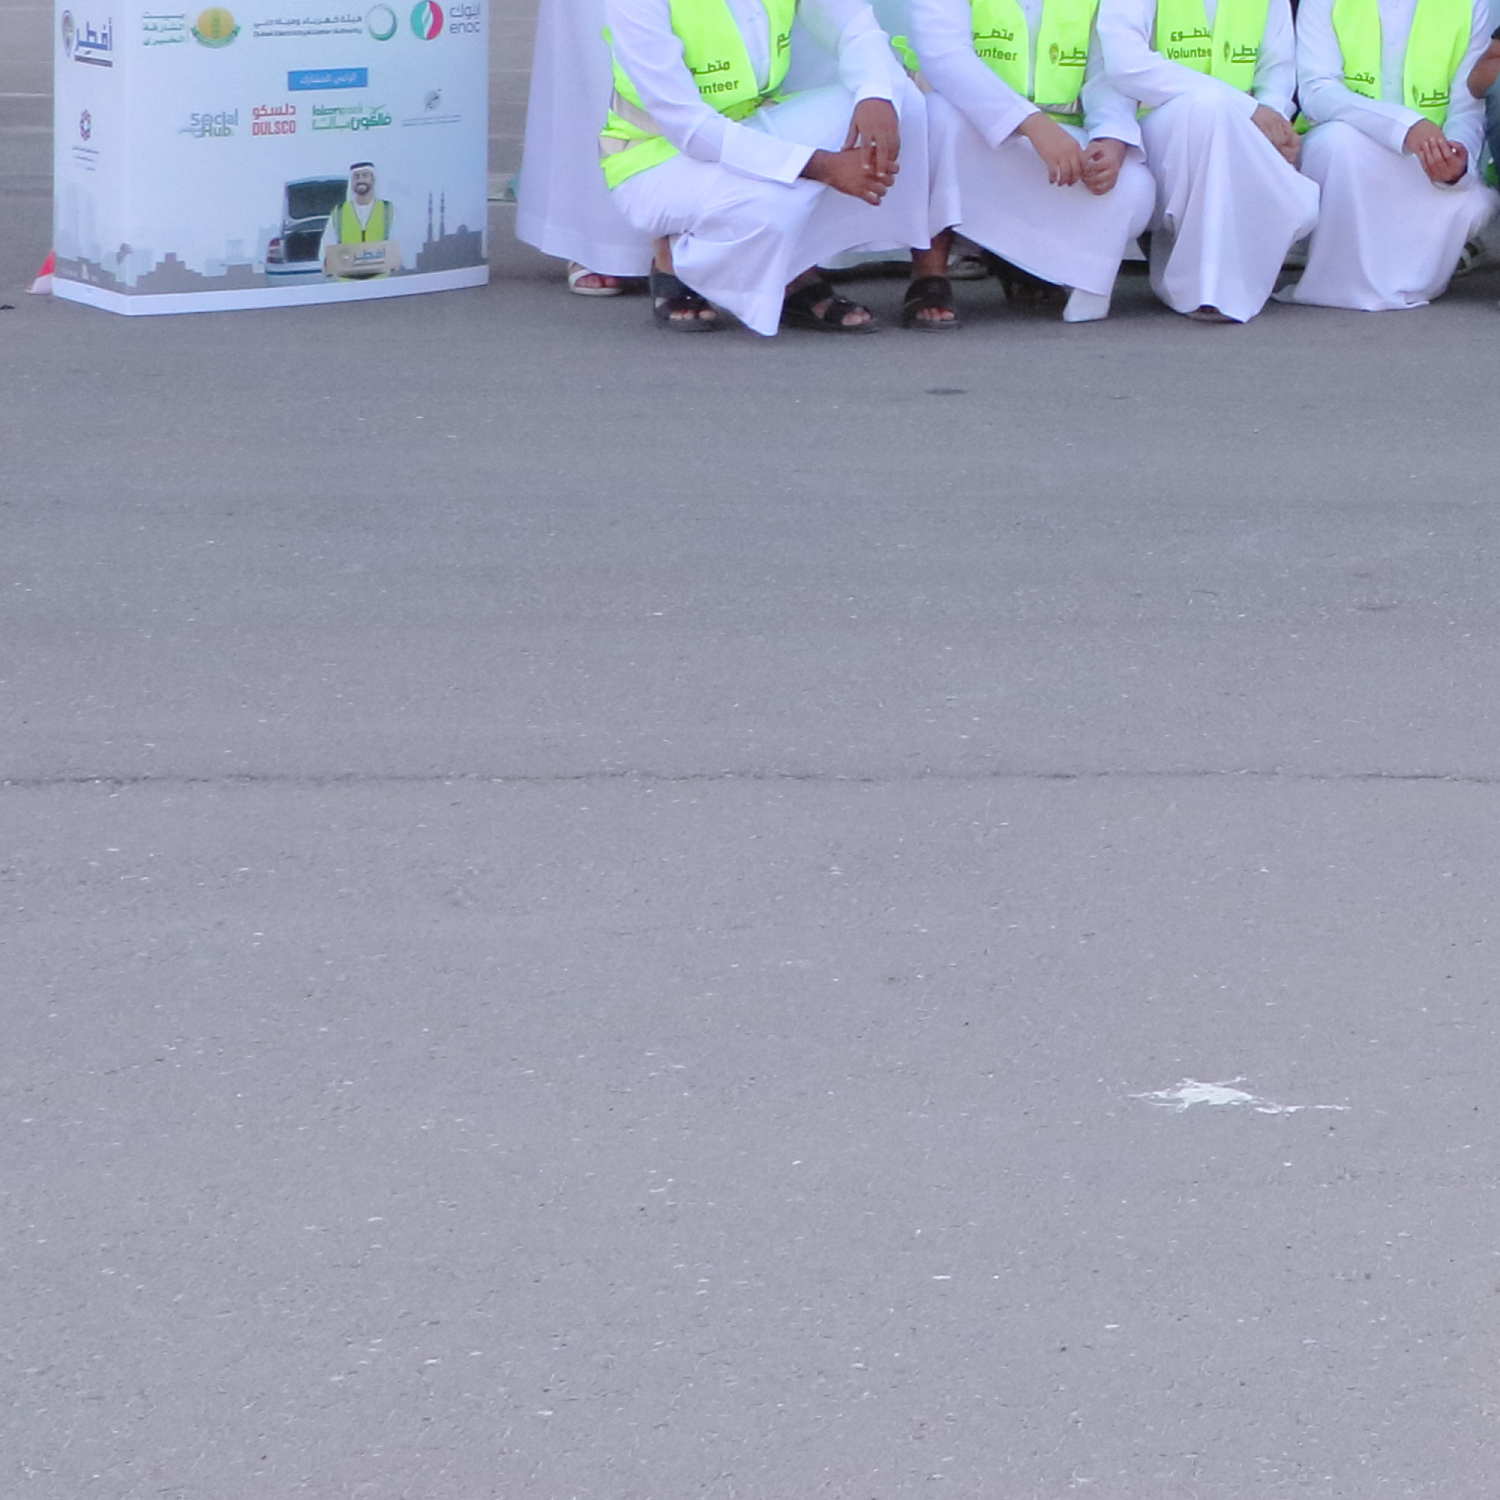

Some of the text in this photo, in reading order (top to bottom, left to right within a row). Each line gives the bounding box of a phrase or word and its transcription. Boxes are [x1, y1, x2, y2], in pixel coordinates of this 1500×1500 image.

[449, 21, 481, 34] enoc
[975, 47, 1018, 61] unteer
[1167, 47, 1212, 59] Voluntee
[252, 103, 297, 120] دلسكو
[252, 120, 296, 137] DULSCO
